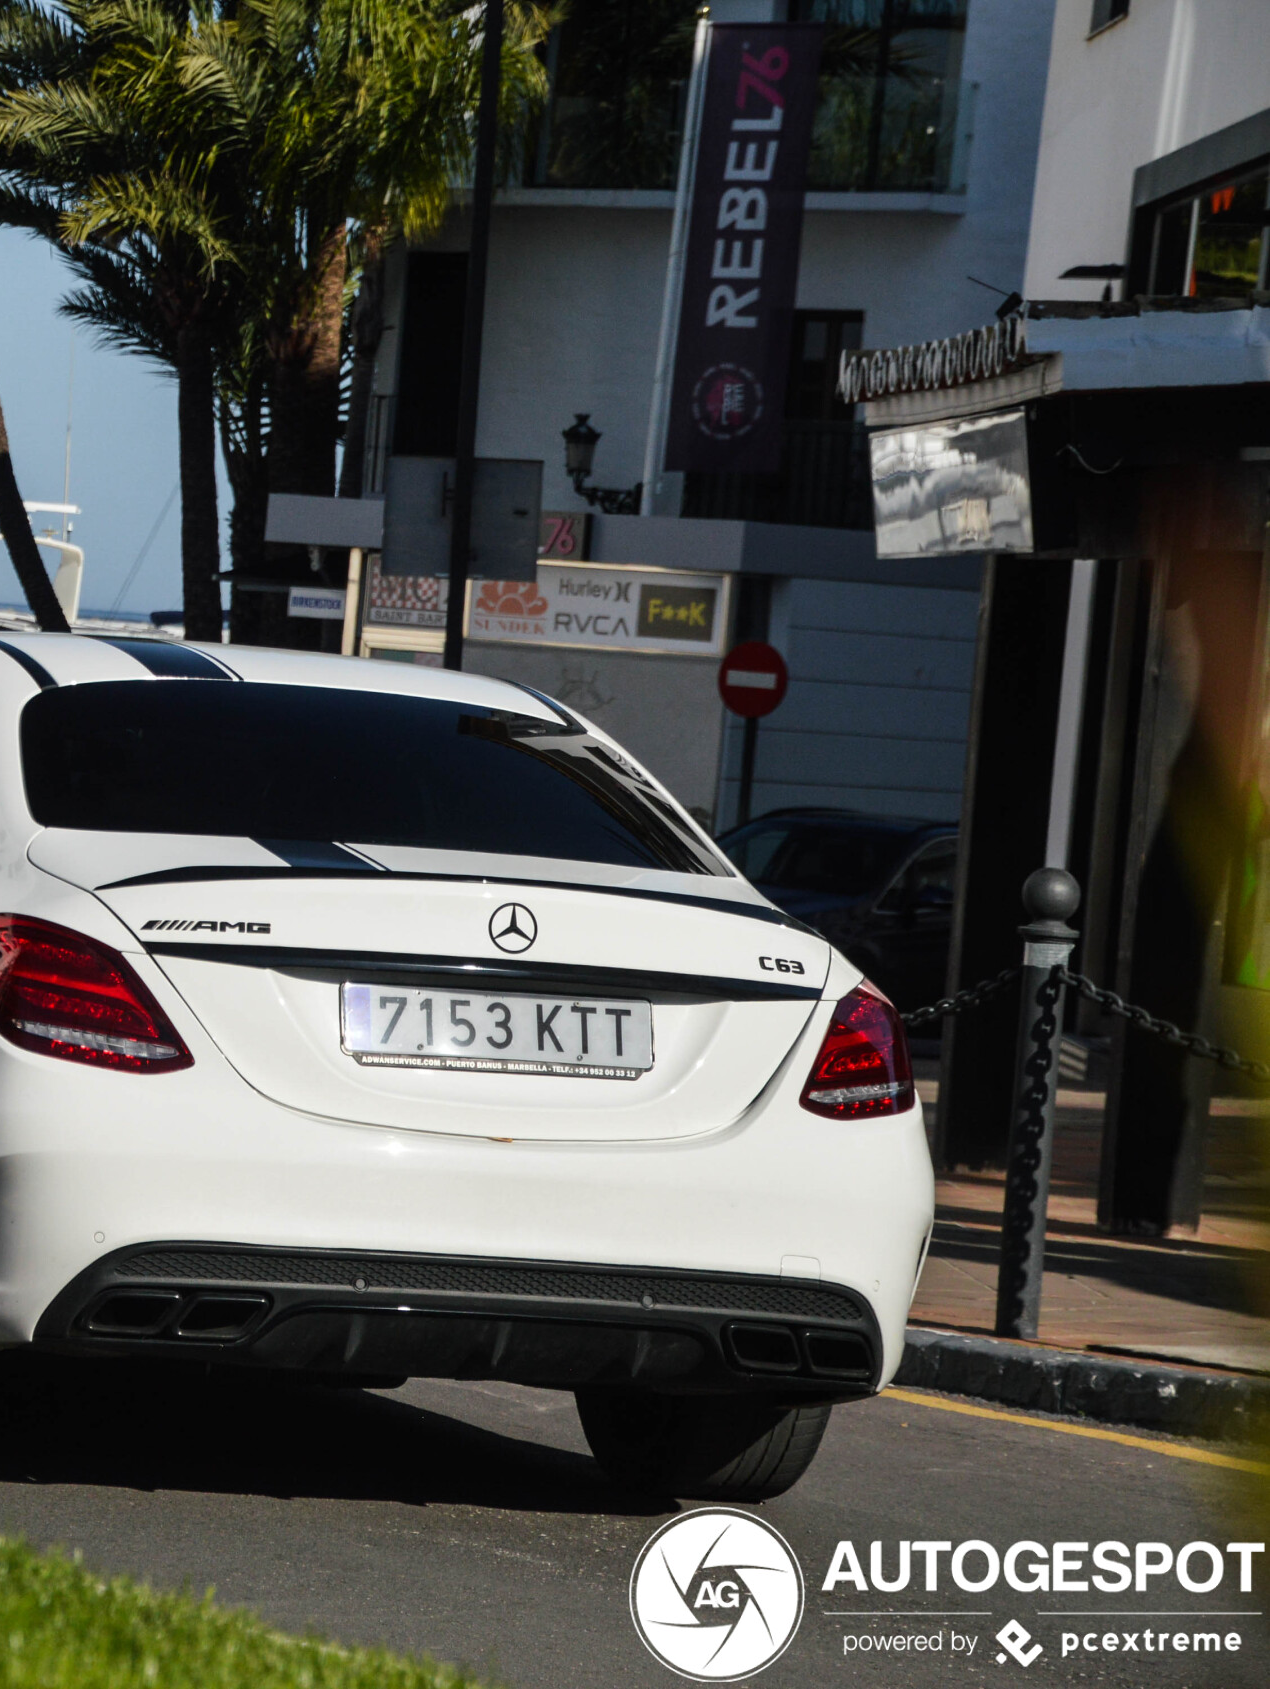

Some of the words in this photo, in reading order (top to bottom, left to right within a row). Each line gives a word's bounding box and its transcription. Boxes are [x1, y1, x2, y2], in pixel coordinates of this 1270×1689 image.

[705, 46, 790, 329] REBEL76
[558, 578, 613, 600] Hurley
[374, 610, 413, 622] SAINT
[474, 618, 545, 635] SUNDEK
[553, 612, 629, 637] RVCA
[190, 920, 272, 935] AMG
[758, 956, 806, 975] C63
[379, 996, 514, 1050] 7153
[535, 1003, 633, 1057] KTT
[361, 1056, 441, 1067] ADWANSERVICE.COM
[446, 1061, 475, 1069] PUERTO
[477, 1062, 502, 1070] BANUS
[507, 1063, 548, 1073] MARBELLA
[574, 1067, 589, 1075] +34
[589, 1068, 604, 1076] 952
[605, 1069, 614, 1077] 00
[615, 1070, 625, 1078] 33
[626, 1070, 636, 1078] 12
